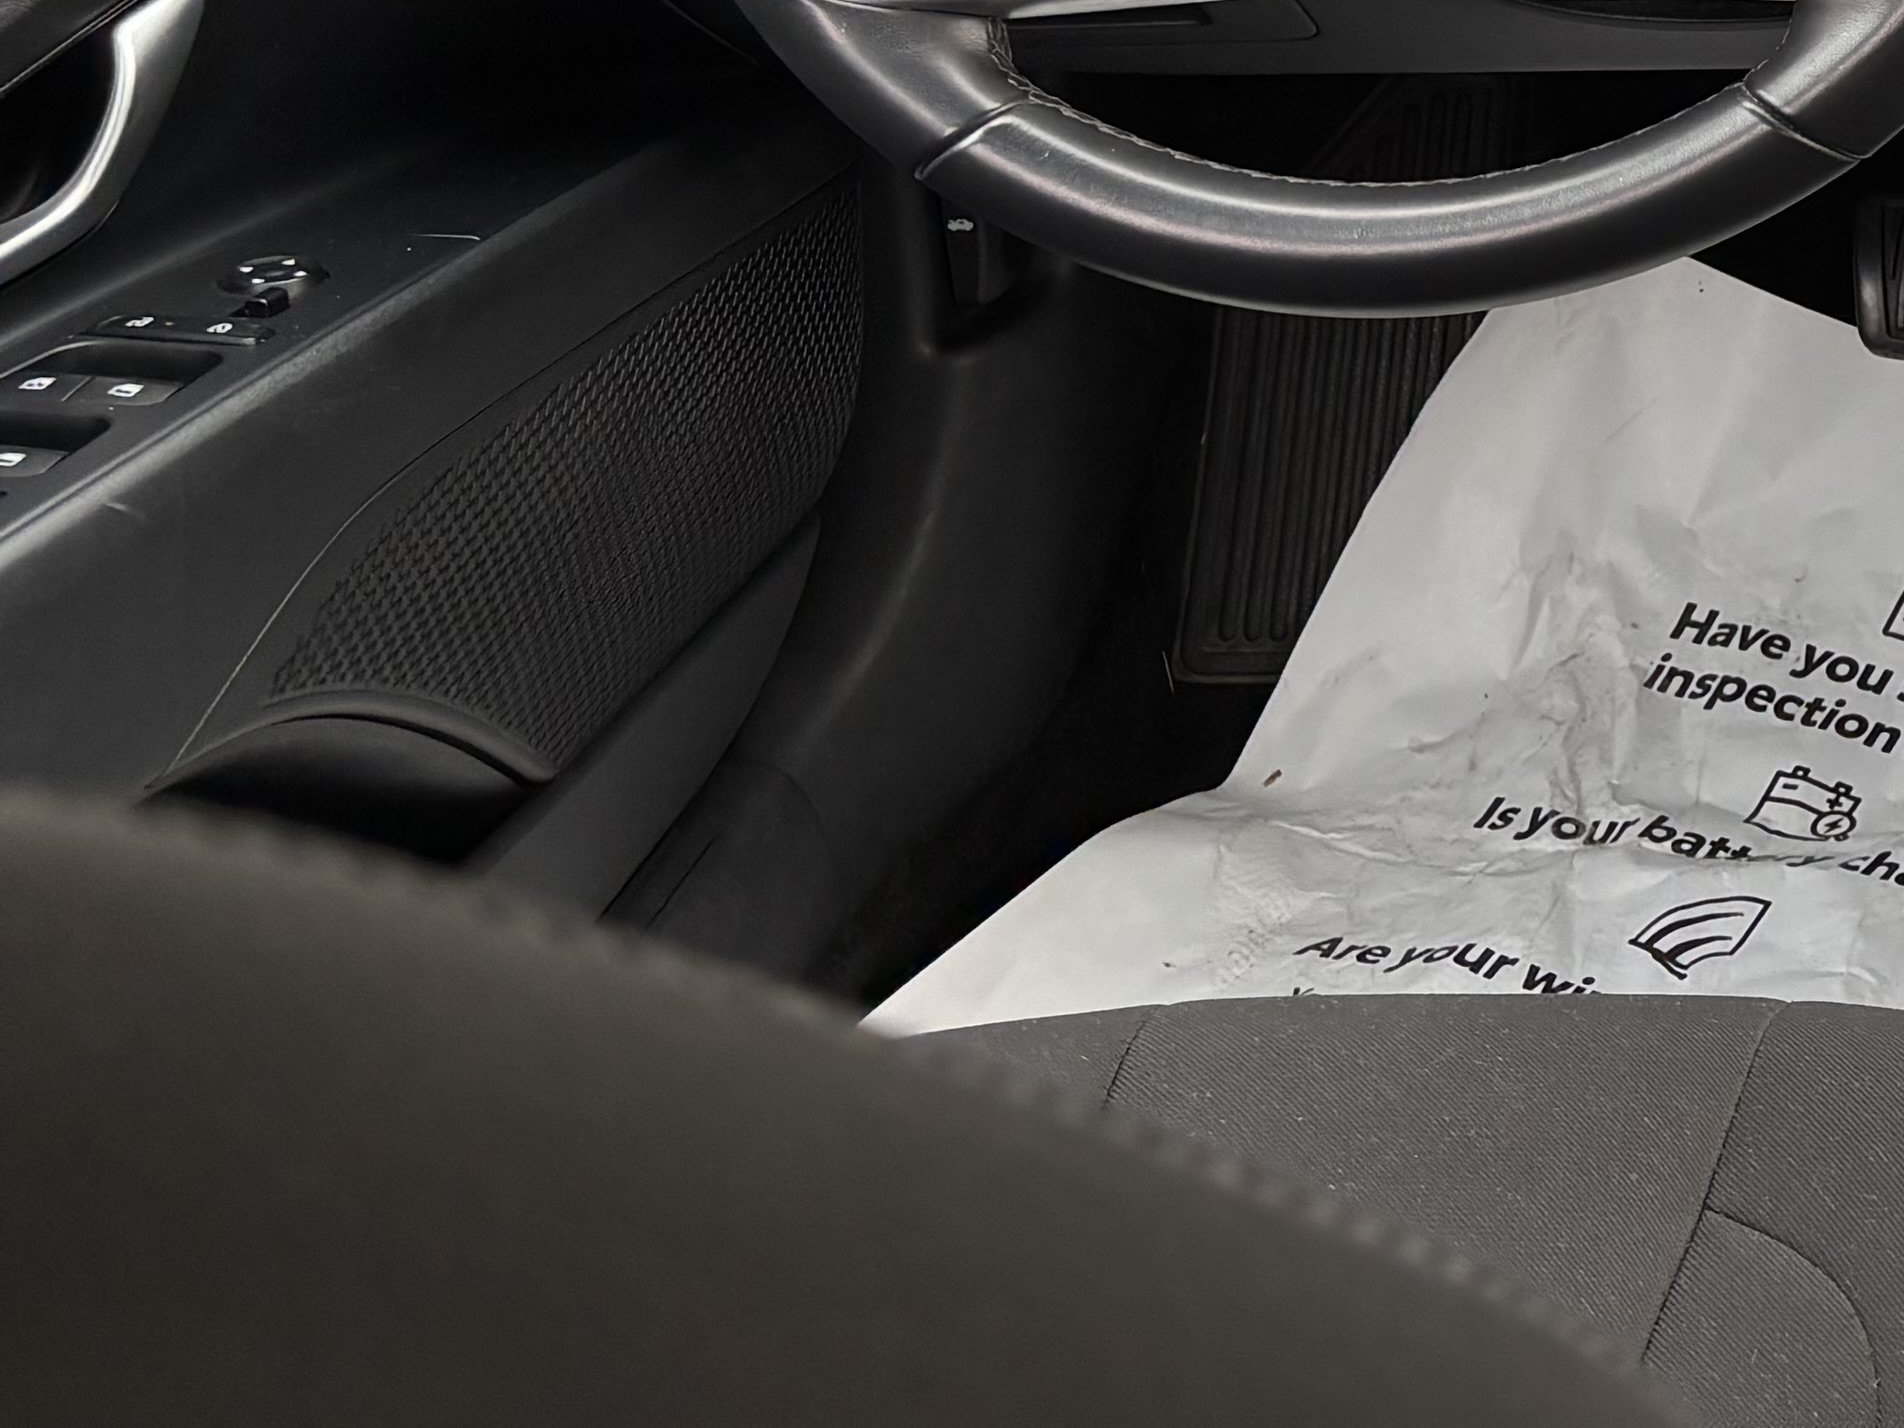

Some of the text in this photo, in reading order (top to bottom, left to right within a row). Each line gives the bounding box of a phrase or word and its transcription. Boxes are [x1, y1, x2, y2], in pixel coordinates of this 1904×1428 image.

[1669, 601, 1792, 660] Have
[1788, 643, 1895, 695] you
[1641, 652, 1902, 755] inspection
[1473, 796, 1522, 830] Is
[1512, 806, 1640, 846] your
[1637, 815, 1836, 868] batty
[1293, 936, 1601, 995] Are your wi
